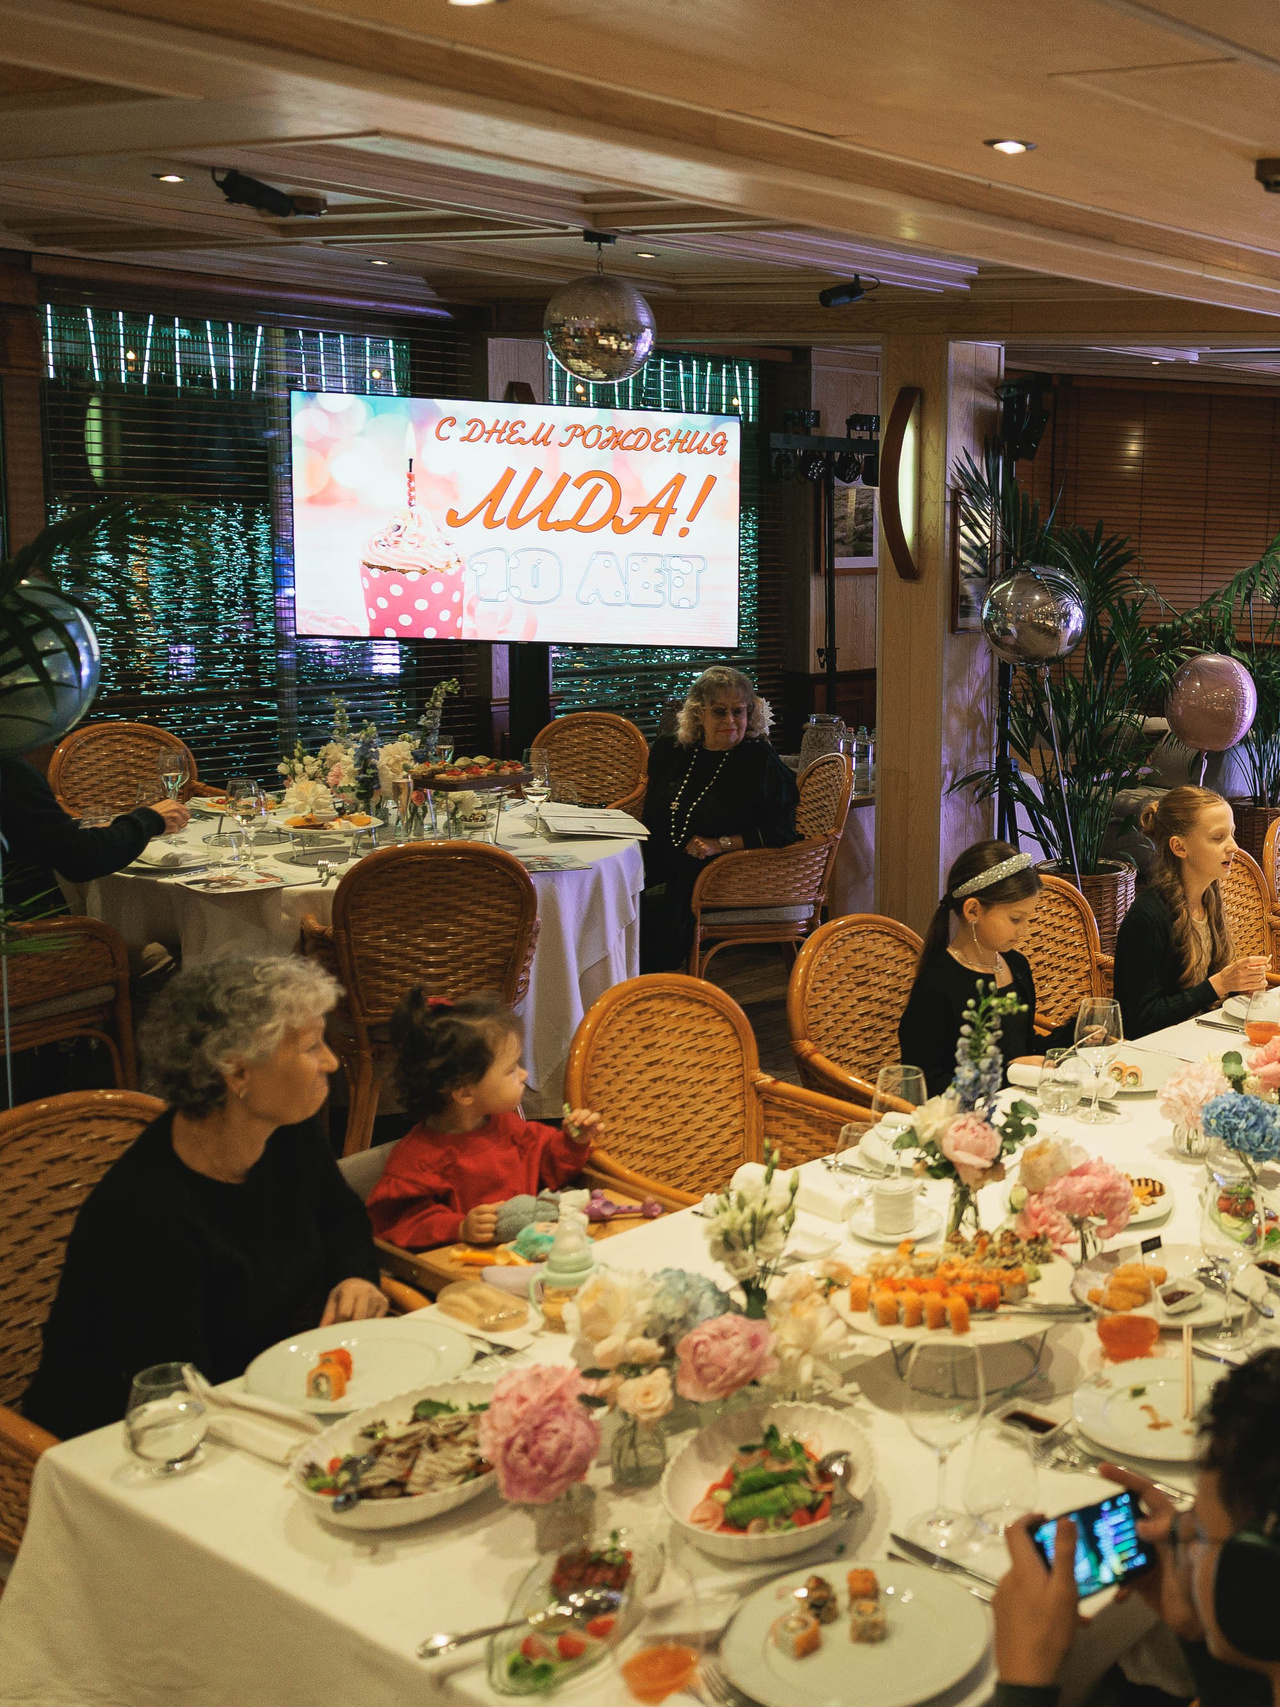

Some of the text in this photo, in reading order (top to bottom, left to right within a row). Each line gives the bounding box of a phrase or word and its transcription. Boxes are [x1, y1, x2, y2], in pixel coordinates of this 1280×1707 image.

[435, 416, 728, 455] С ДНЕМ РОЖДЕНИЯ
[446, 466, 717, 537] ЛИДА!
[468, 547, 707, 609] 10 ЛЕТ
